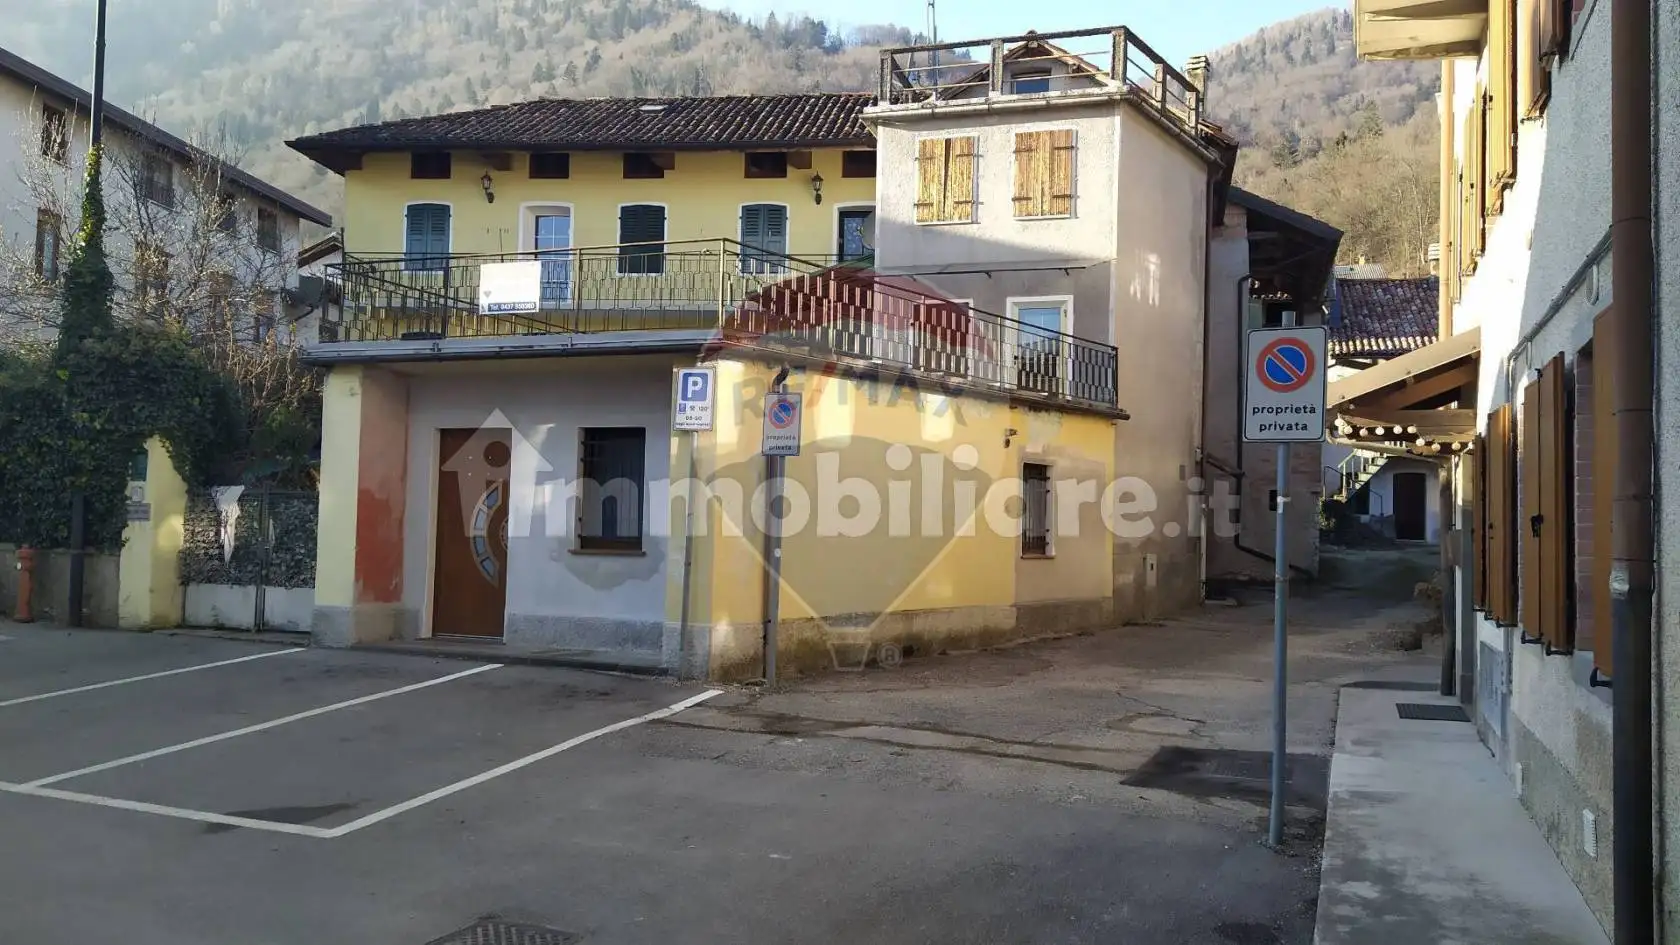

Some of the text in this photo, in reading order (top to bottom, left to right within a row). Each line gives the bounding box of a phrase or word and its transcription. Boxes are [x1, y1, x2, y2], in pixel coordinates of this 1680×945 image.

[688, 376, 703, 398] P
[1252, 404, 1316, 416] proprietà
[1259, 421, 1308, 432] privata
